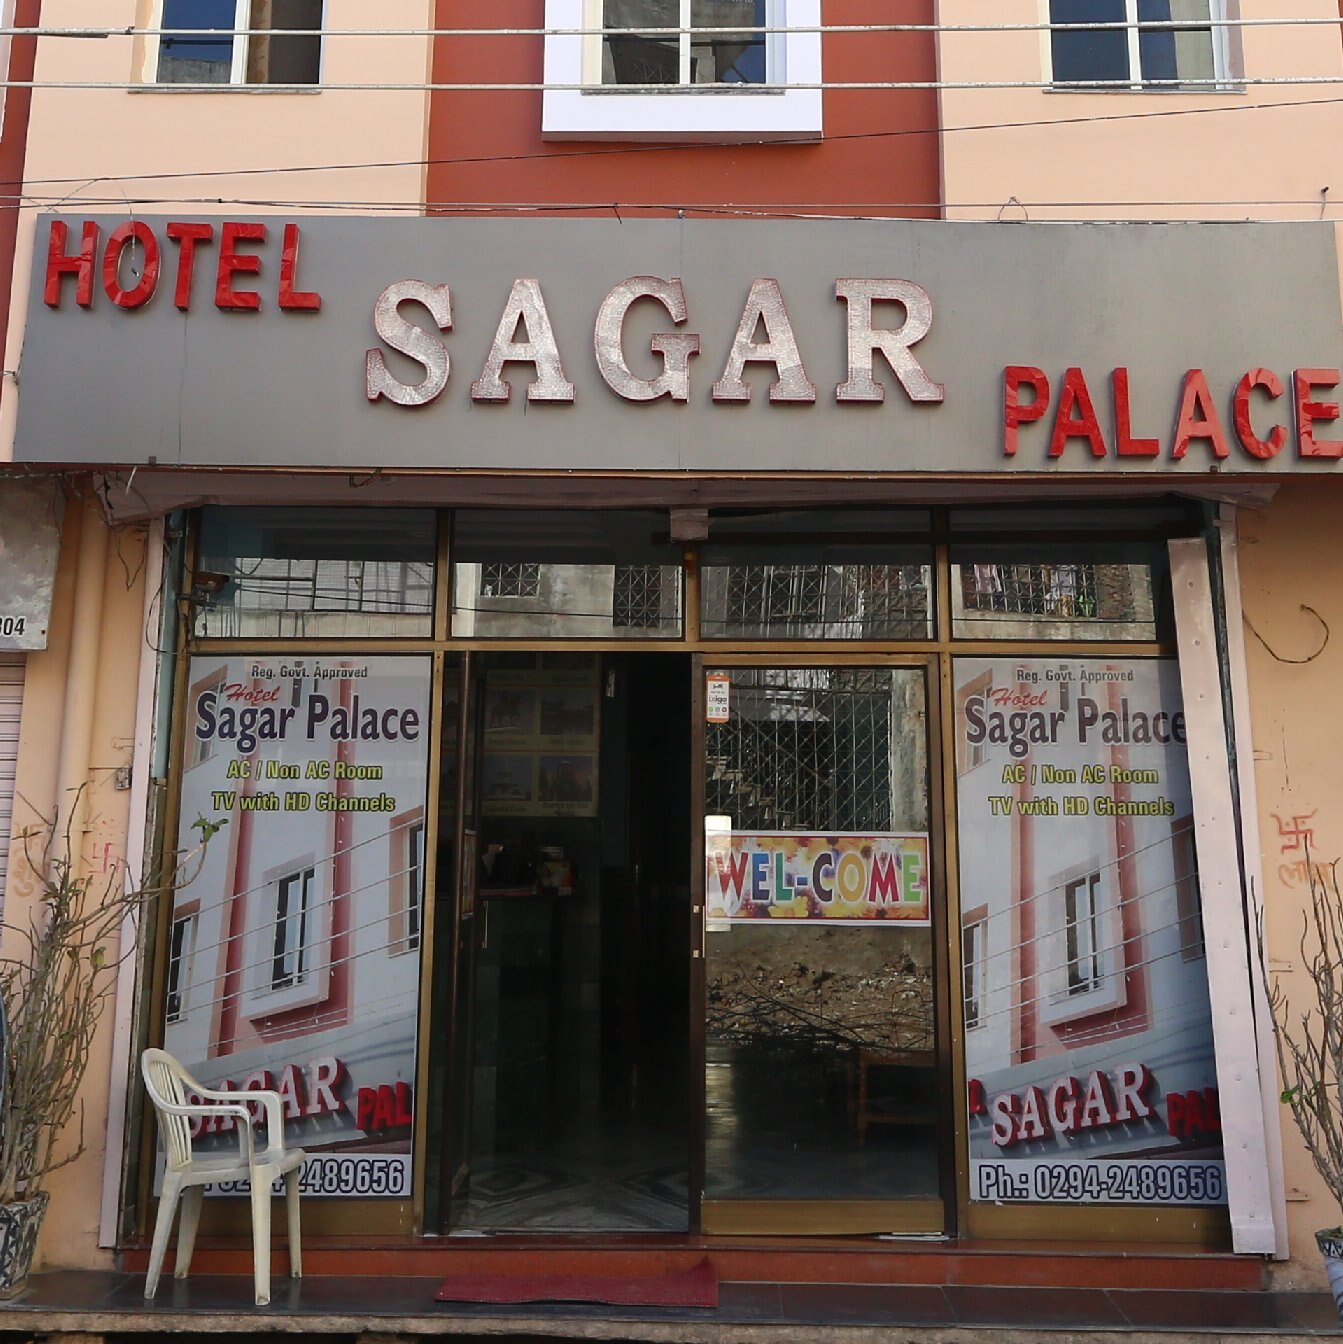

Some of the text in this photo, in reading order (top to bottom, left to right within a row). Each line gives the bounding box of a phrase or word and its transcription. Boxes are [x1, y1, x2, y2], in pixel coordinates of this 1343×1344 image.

[44, 218, 322, 312] HOTEL
[365, 275, 946, 406] SAGAR
[251, 665, 368, 680] Reg. Govt. Approved
[1016, 669, 1134, 684] Reg. Govt. Approved
[223, 683, 281, 703] Hotel
[990, 687, 1047, 706] Hotel
[195, 692, 420, 754] Sagar Palace
[965, 696, 1187, 758] Sagar Palace
[226, 760, 251, 780] AC
[265, 761, 301, 779] Non
[305, 761, 330, 779] AC
[334, 761, 383, 780] Room
[1002, 764, 1026, 784] AC
[1041, 765, 1076, 784] Non
[1080, 765, 1105, 784] AC
[1110, 765, 1159, 784] Room
[211, 791, 396, 812] TV with HD Channels
[988, 796, 1175, 817] TV with HD Channels
[714, 851, 923, 904] WEL-COME
[991, 1062, 1154, 1147] SAGAR
[1035, 1164, 1222, 1200] 0294-2489656
